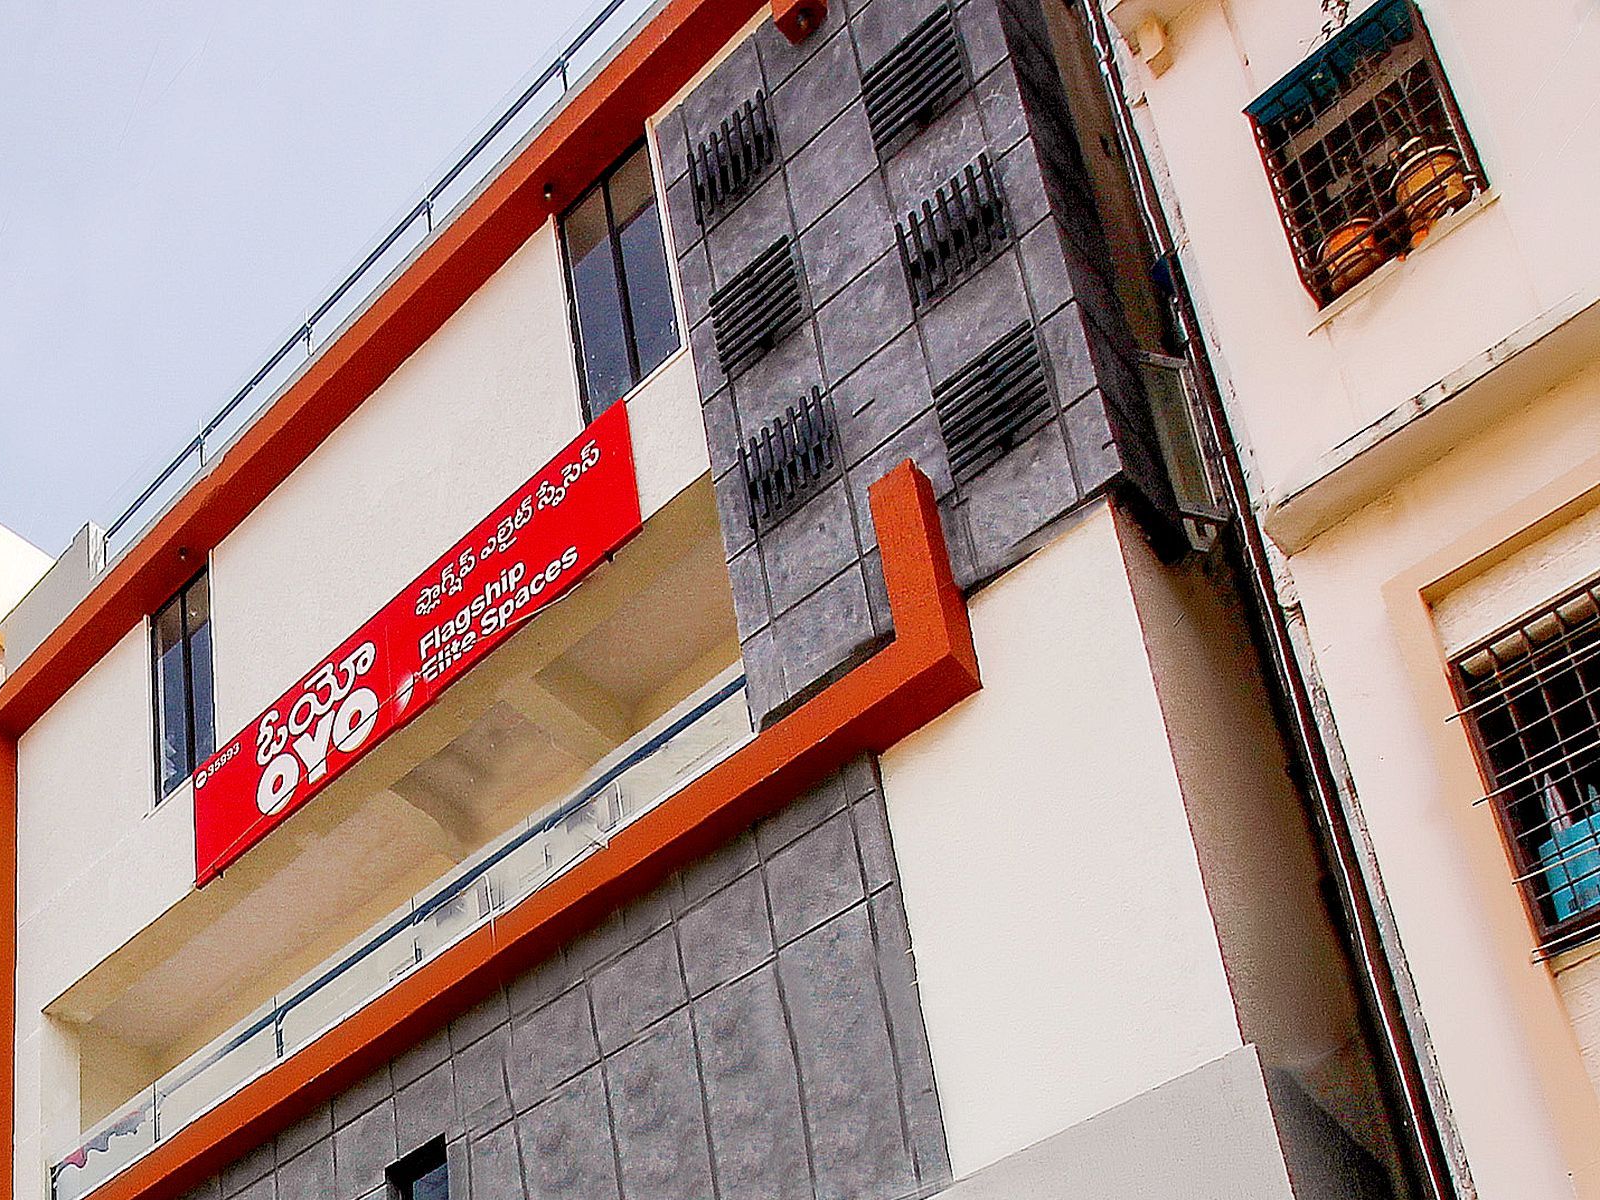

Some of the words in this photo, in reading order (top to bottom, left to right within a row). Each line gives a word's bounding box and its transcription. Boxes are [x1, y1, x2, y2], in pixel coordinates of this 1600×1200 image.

[419, 562, 526, 661] Flagship
[421, 630, 478, 682] Elite
[480, 546, 579, 635] Spaces
[207, 741, 240, 777] 35993
[256, 641, 376, 766] ఓయో
[257, 687, 380, 816] OYO
